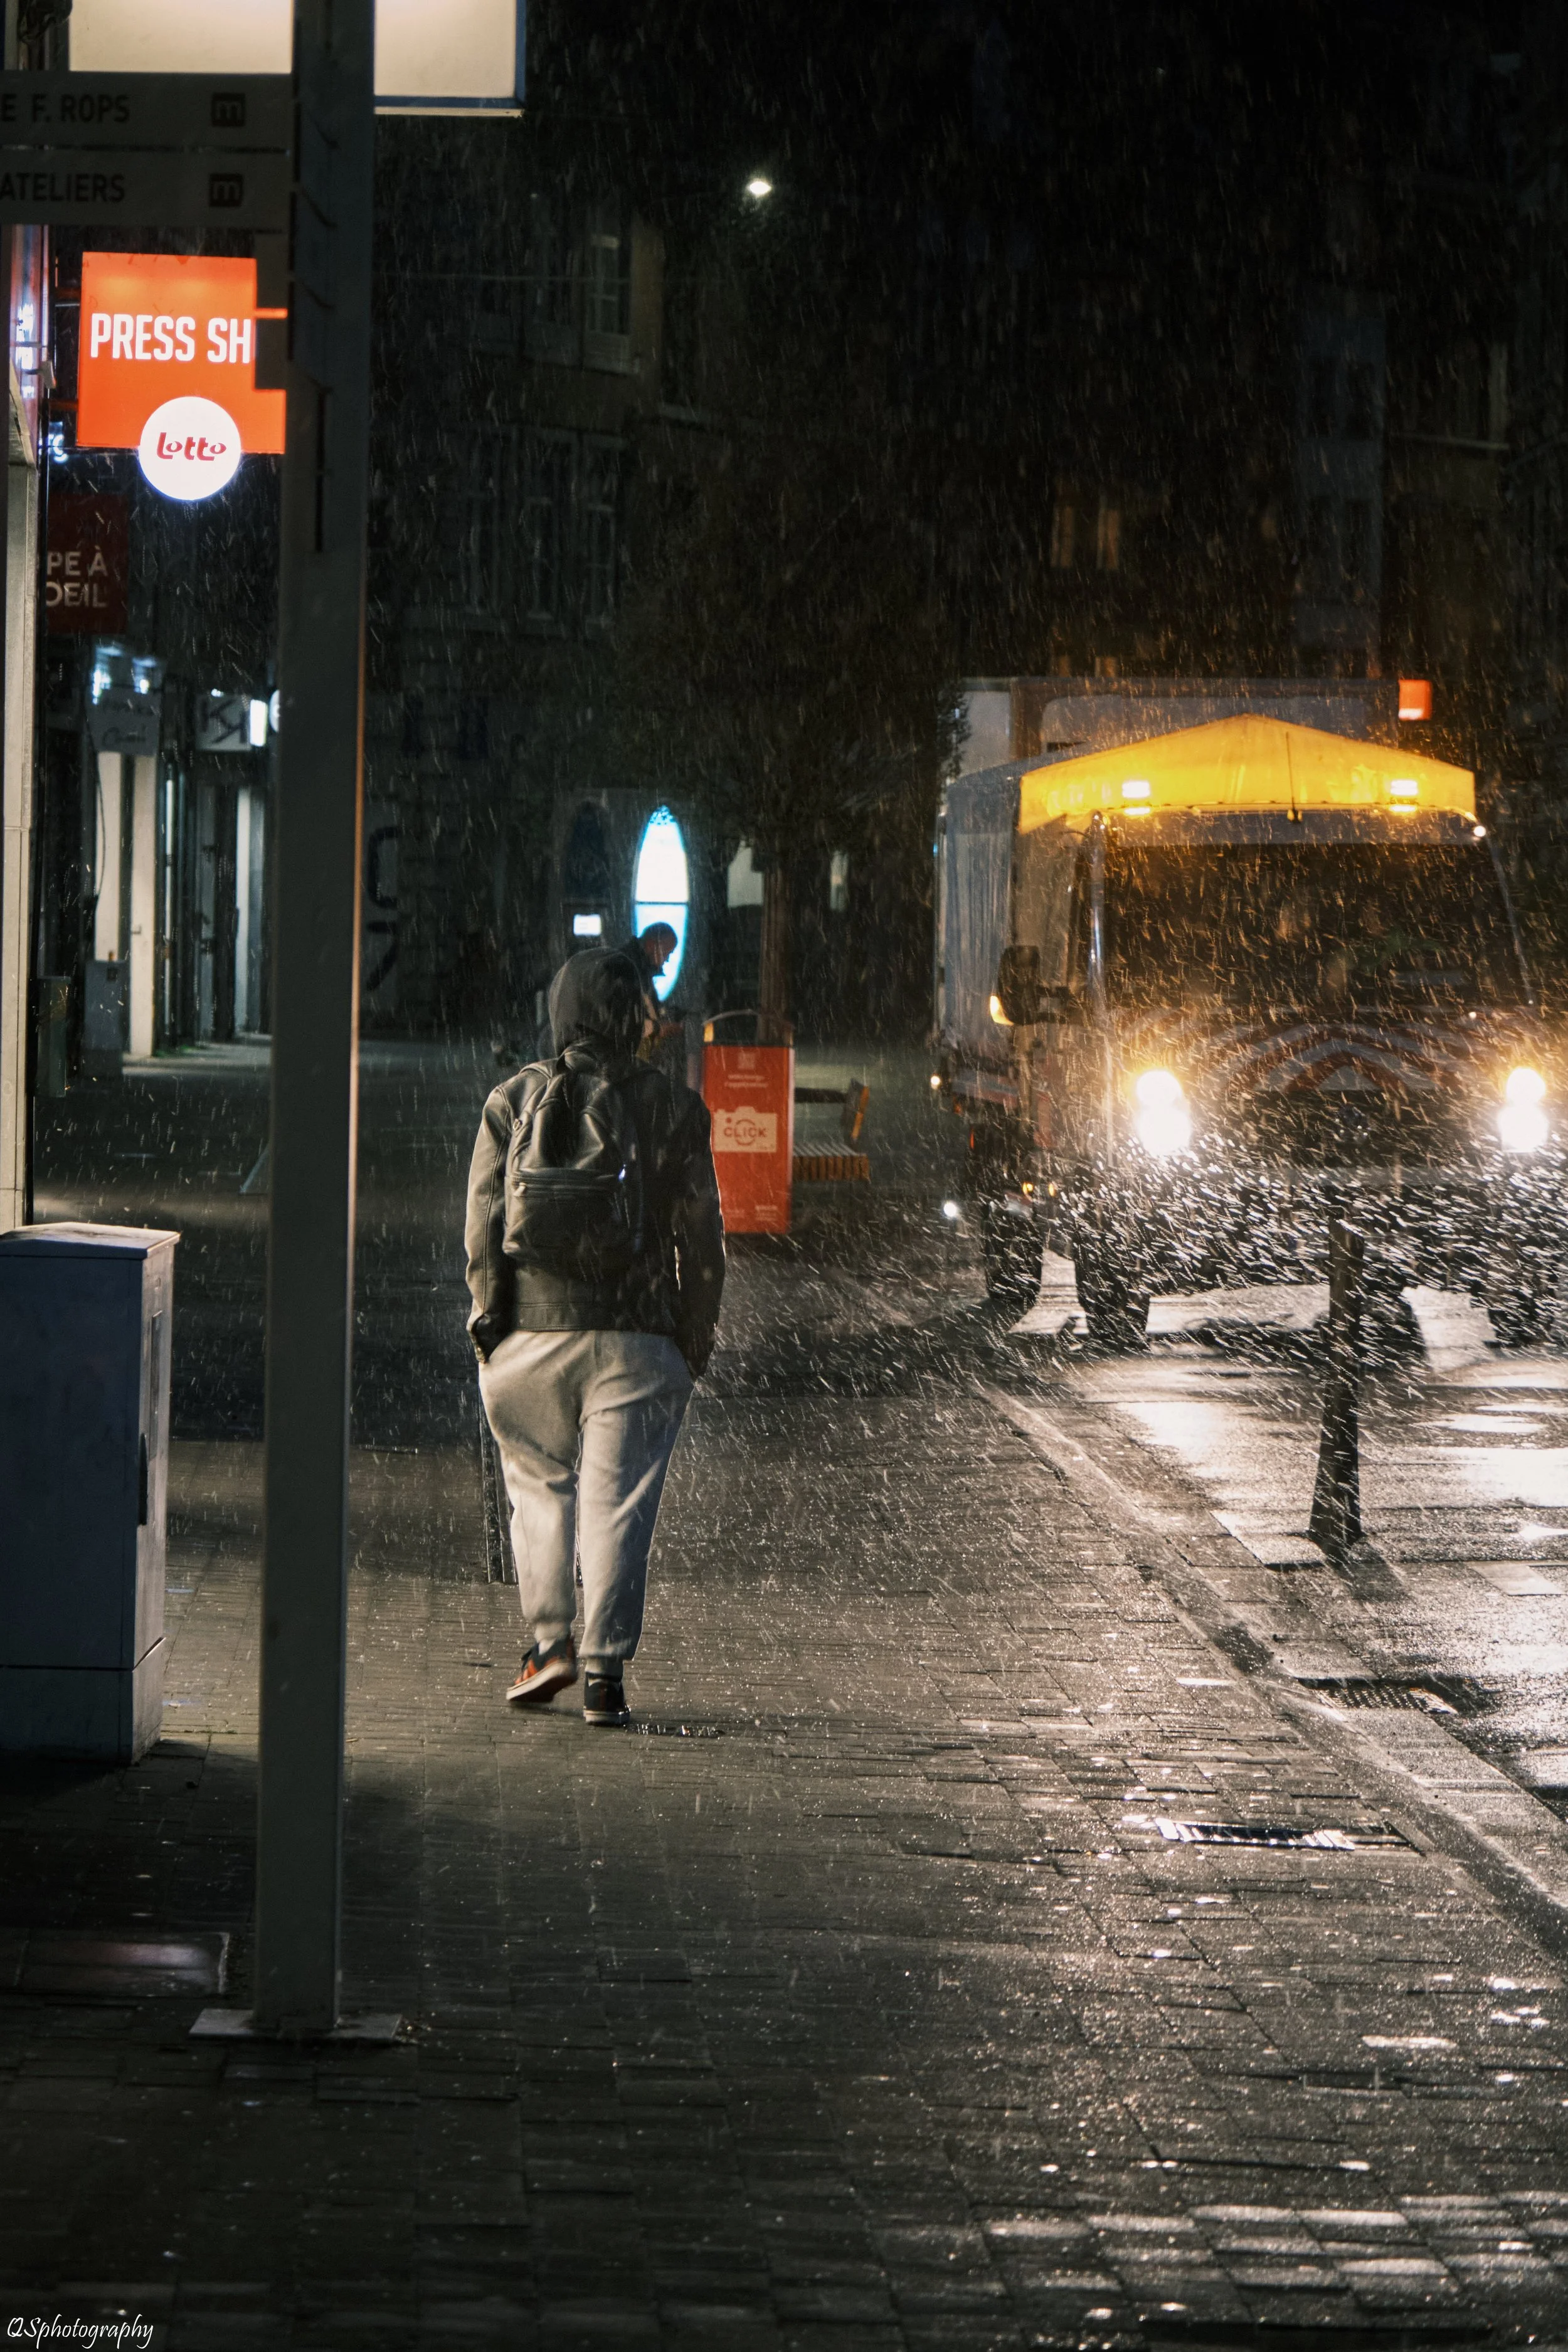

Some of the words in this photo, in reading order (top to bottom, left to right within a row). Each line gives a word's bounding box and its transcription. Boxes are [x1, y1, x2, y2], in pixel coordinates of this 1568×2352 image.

[33, 94, 51, 122] F.
[61, 94, 129, 122] ROPS
[0, 172, 125, 202] ATELIERS
[90, 313, 196, 361] PRESS
[207, 317, 252, 364] SH
[88, 544, 108, 576] À
[724, 1127, 766, 1137] CLICK
